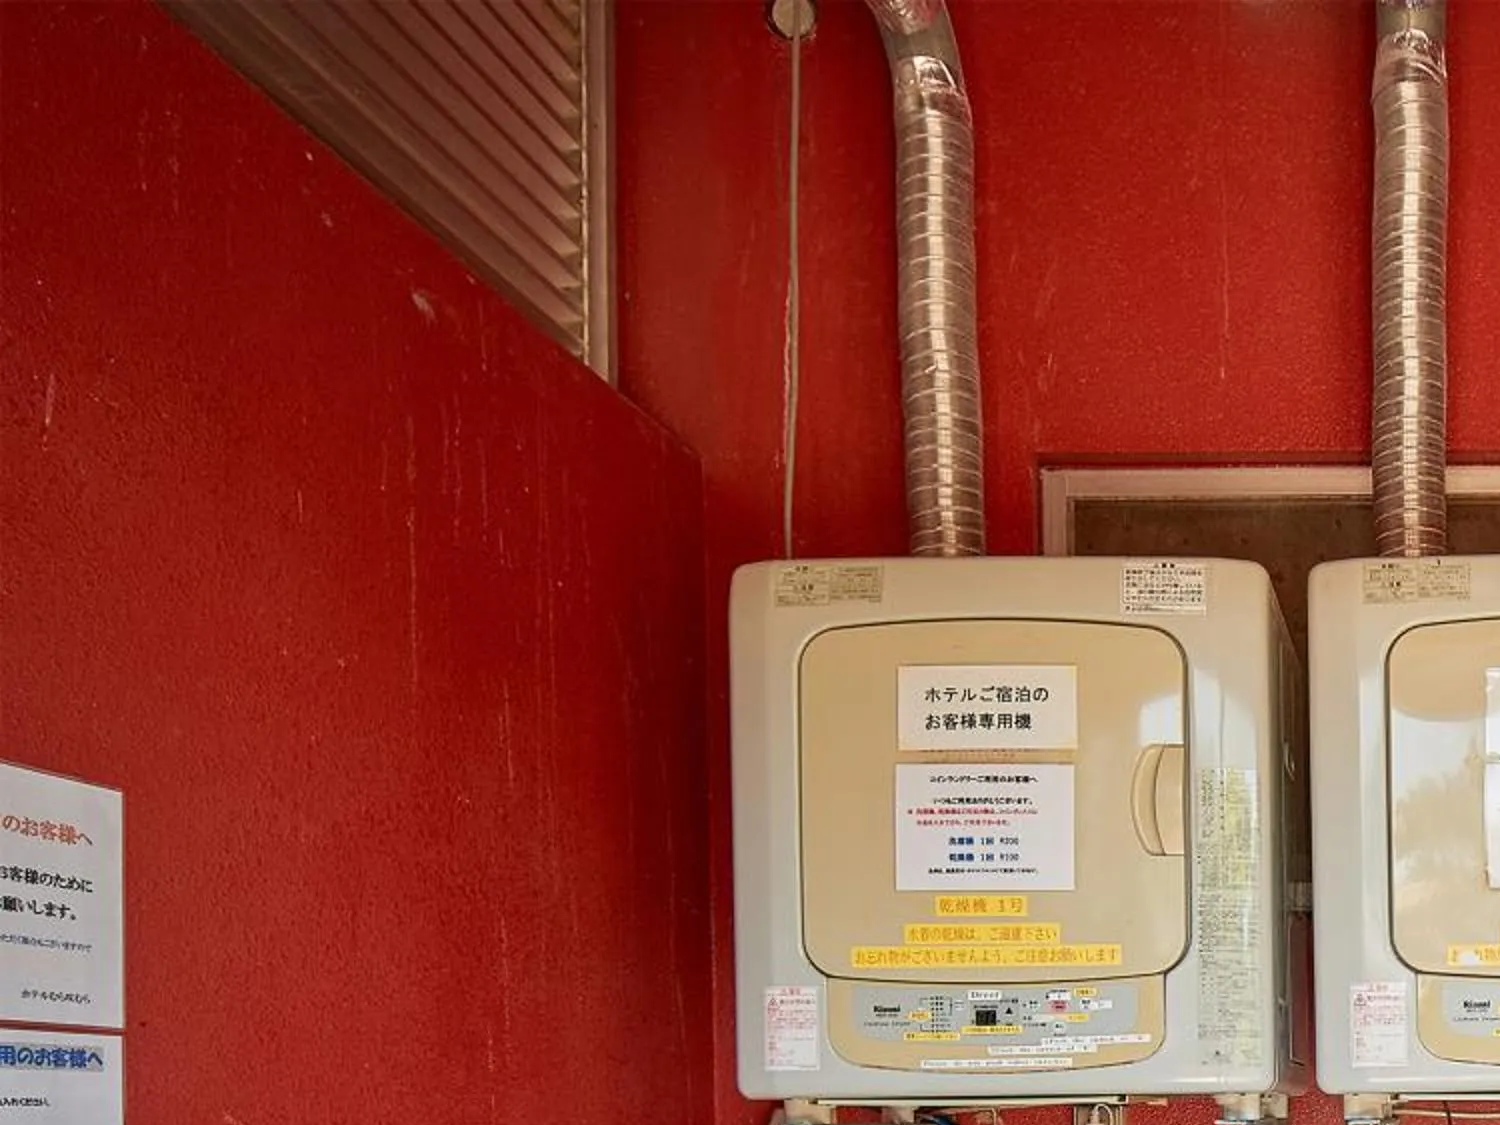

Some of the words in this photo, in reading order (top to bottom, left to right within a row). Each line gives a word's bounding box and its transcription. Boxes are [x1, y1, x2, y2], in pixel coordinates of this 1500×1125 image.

[925, 686, 1049, 703] ホテルご宿泊の
[925, 713, 1032, 731] お客様専用機
[2, 815, 93, 845] のお客様へ
[0, 895, 76, 921] 願いします。
